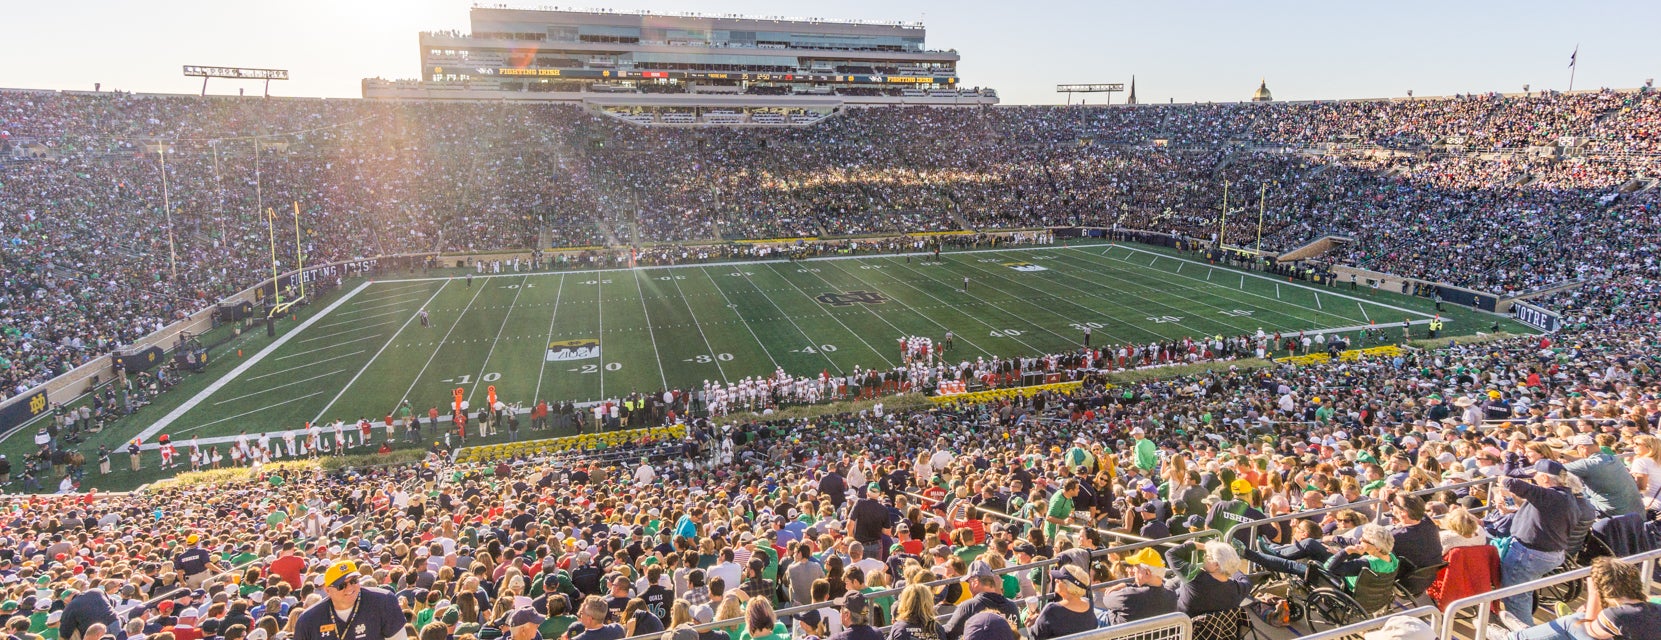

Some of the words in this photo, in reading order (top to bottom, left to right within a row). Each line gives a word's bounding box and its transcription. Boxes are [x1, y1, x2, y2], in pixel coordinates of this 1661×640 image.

[499, 68, 537, 76] FIGHTING
[695, 352, 735, 364] 30
[580, 362, 623, 374] 20
[455, 372, 502, 385] 10
[1223, 511, 1255, 524] USHER
